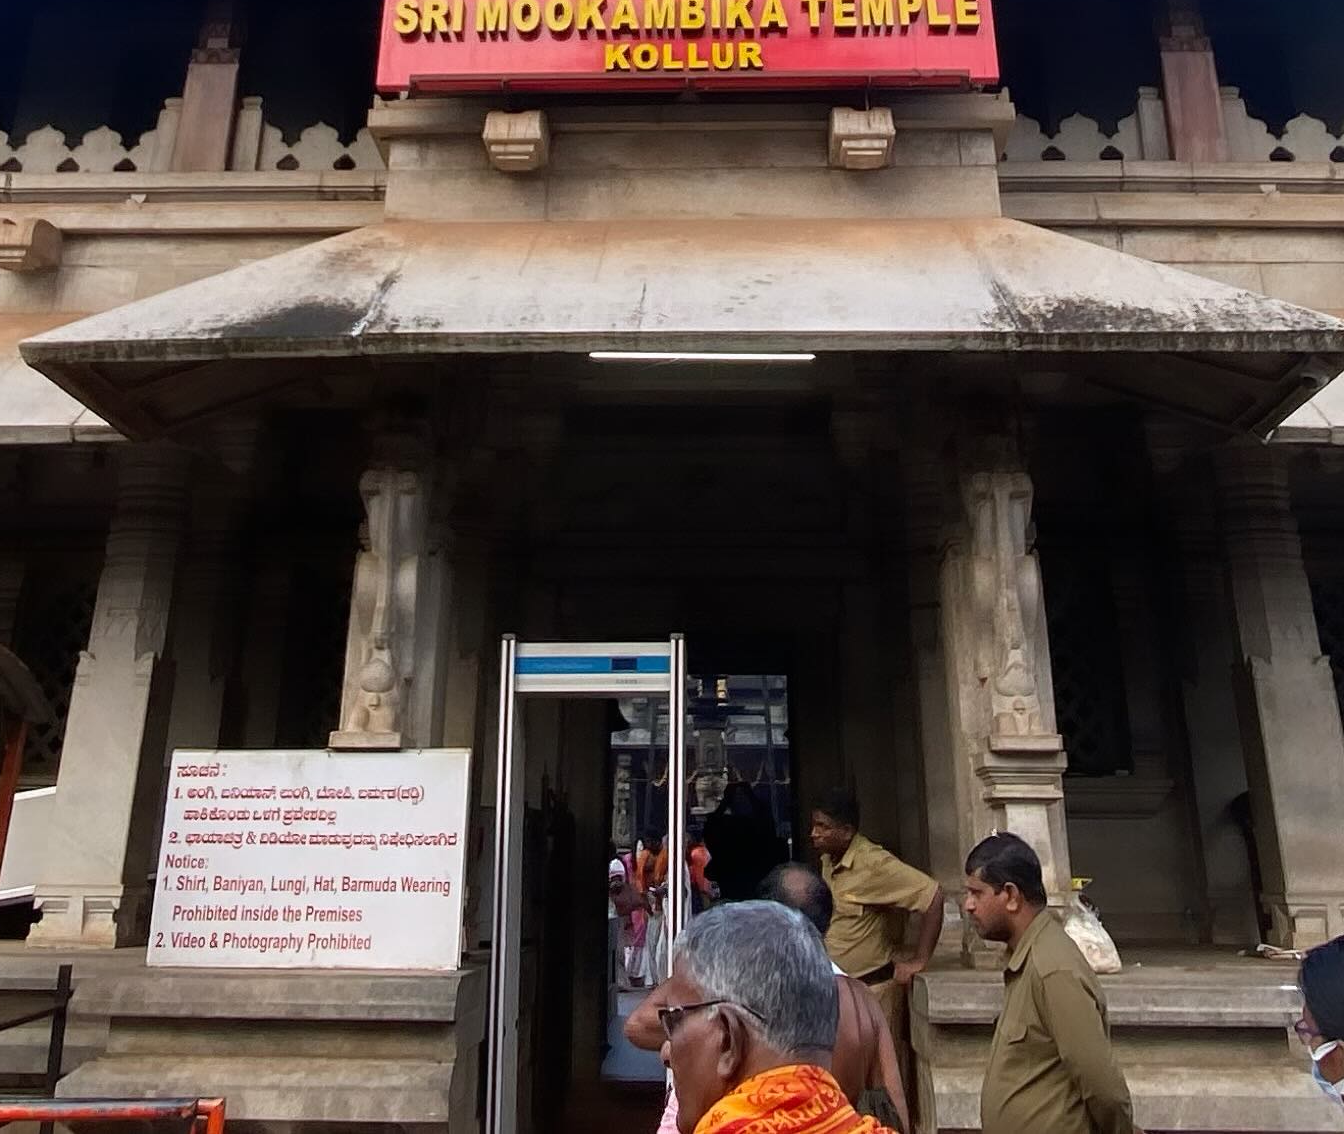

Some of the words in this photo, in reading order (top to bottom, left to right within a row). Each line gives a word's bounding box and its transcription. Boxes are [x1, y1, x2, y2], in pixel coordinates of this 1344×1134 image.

[605, 42, 763, 70] KOLLUR
[174, 786, 184, 799] 1.
[168, 831, 182, 844] 2.
[246, 831, 256, 844] &
[165, 854, 209, 869] Notice:
[162, 875, 173, 891] 1.
[176, 875, 209, 894] Shirt,
[213, 875, 267, 895] Baniyan,
[271, 876, 309, 896] Lungi,
[313, 876, 337, 895] Hat,
[341, 876, 397, 892] Barmuda
[400, 876, 451, 897] Wearing
[172, 905, 237, 921] Prohibited
[240, 905, 279, 922] inside
[282, 906, 302, 922] the
[305, 906, 363, 922] Premises
[155, 932, 166, 948] 2.
[171, 932, 206, 948] Video
[209, 932, 218, 948] &
[222, 932, 303, 953] Photography
[307, 933, 372, 950] Prohibited
